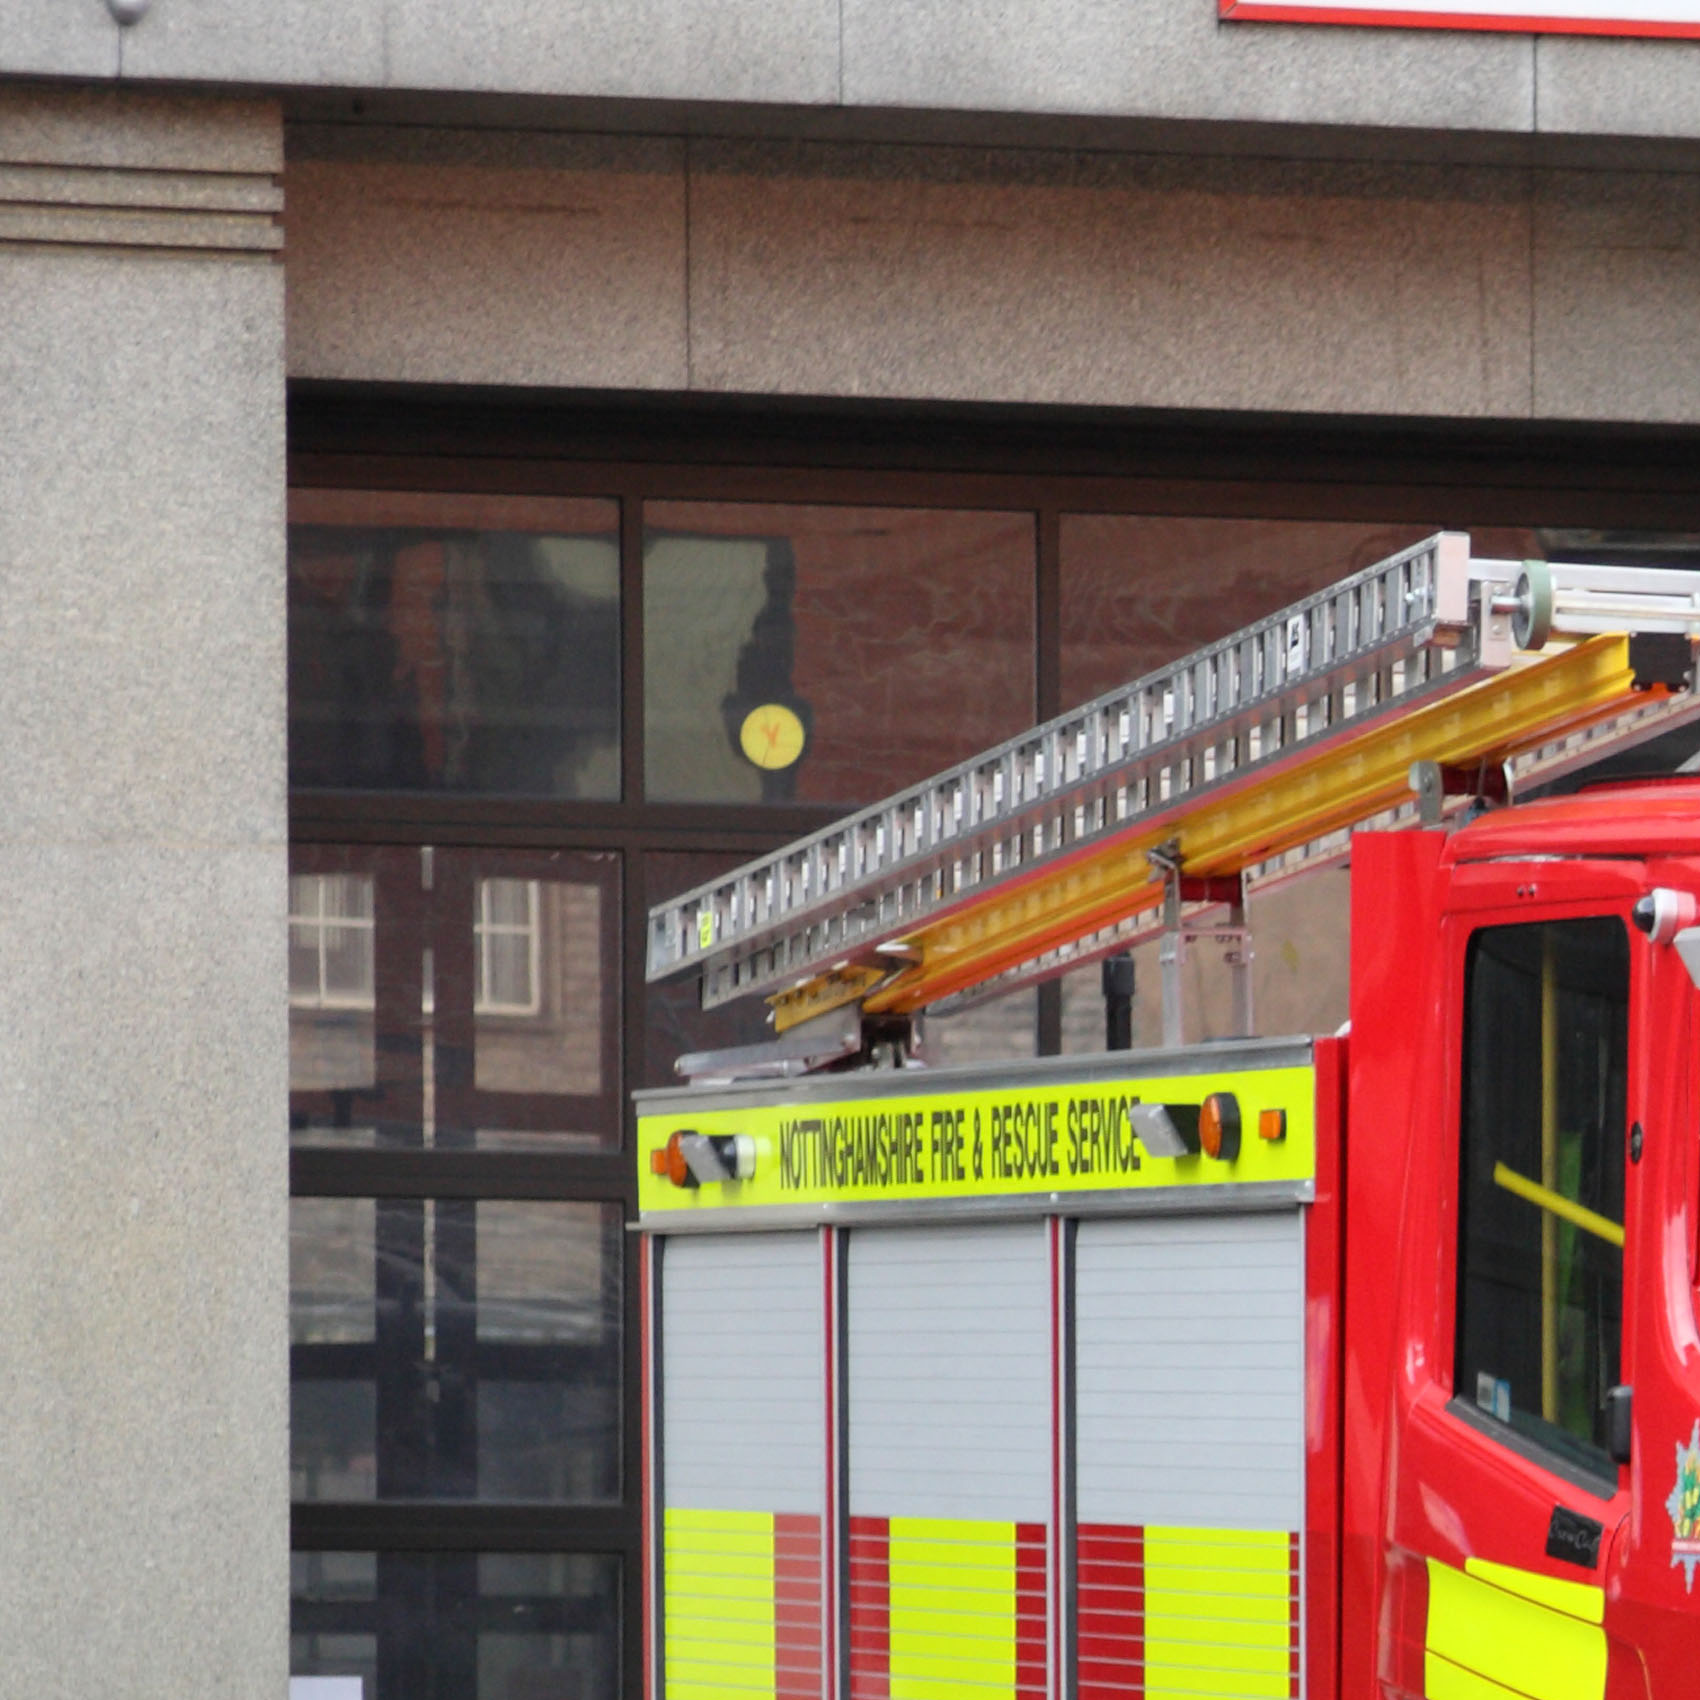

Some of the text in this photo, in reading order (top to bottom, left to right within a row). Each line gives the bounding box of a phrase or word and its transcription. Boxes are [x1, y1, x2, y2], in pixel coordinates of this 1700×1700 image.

[780, 1094, 1142, 1190] NOTTINGHAMSHIRE FIRE & RESCUE SERVICE
